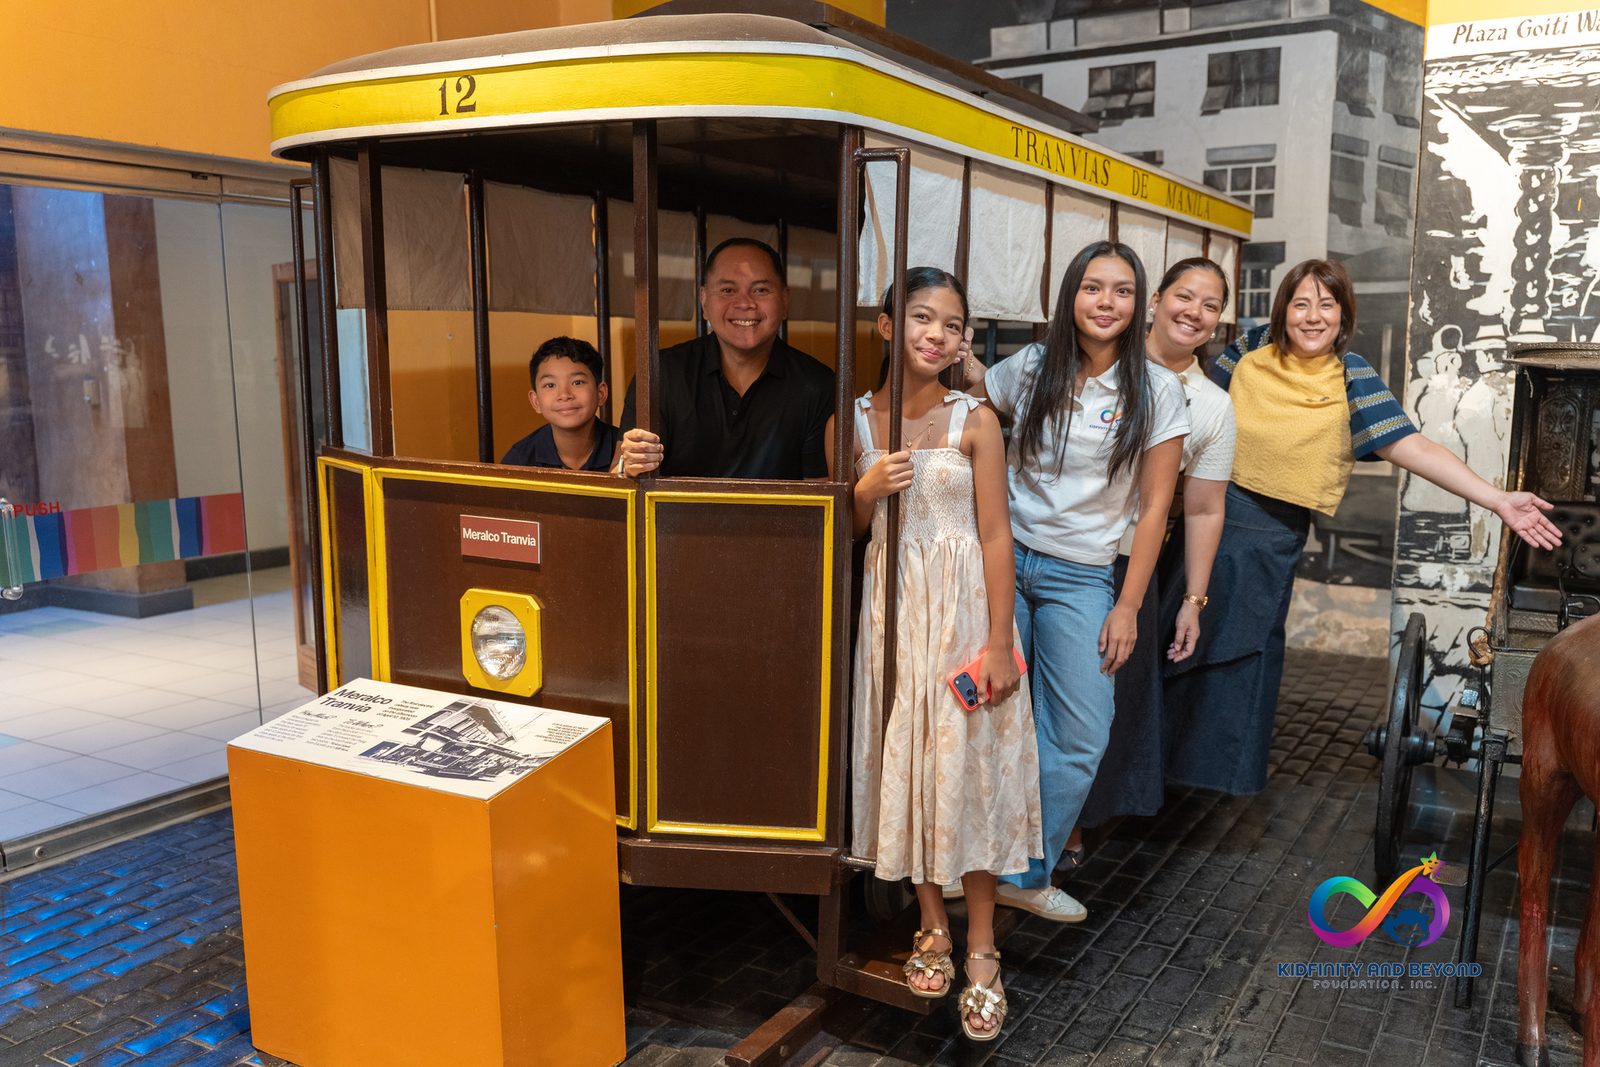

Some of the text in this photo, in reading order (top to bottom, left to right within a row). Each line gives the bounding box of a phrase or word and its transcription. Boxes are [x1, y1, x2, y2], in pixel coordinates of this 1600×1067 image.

[1517, 15, 1568, 39] Goiti
[438, 74, 476, 115] 12
[1011, 126, 1210, 220] TRANVIAS DE MANILA
[14, 501, 60, 517] PUSH
[462, 528, 536, 547] Meralco Tranvia
[320, 696, 372, 713] Tranvia
[334, 688, 393, 705] Meralco
